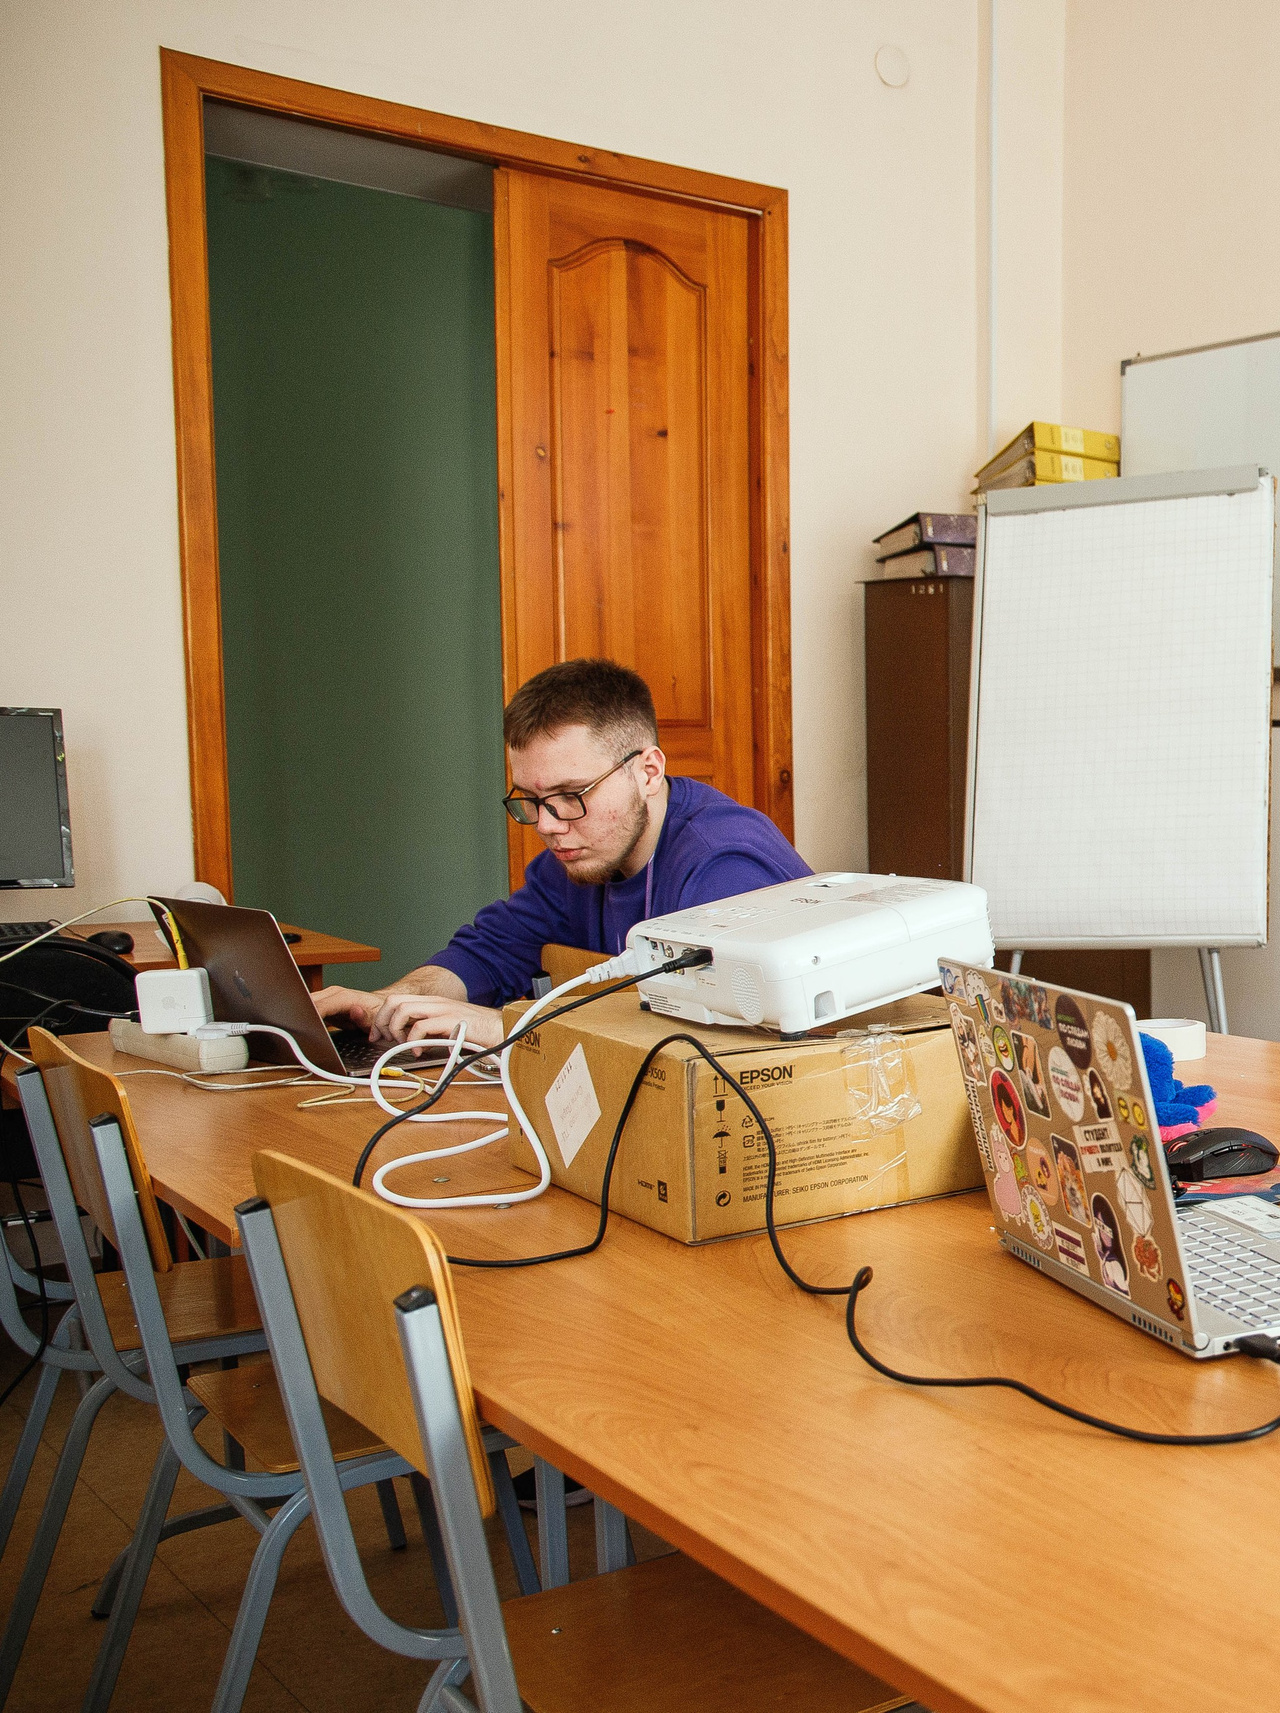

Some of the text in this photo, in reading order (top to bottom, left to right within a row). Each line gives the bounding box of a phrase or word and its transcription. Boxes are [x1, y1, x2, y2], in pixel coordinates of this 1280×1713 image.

[740, 1065, 793, 1085] EPSON
[792, 1184, 809, 1194] SEIKO
[810, 1181, 829, 1191] EPSON
[830, 1175, 869, 1188] CORPORATION
